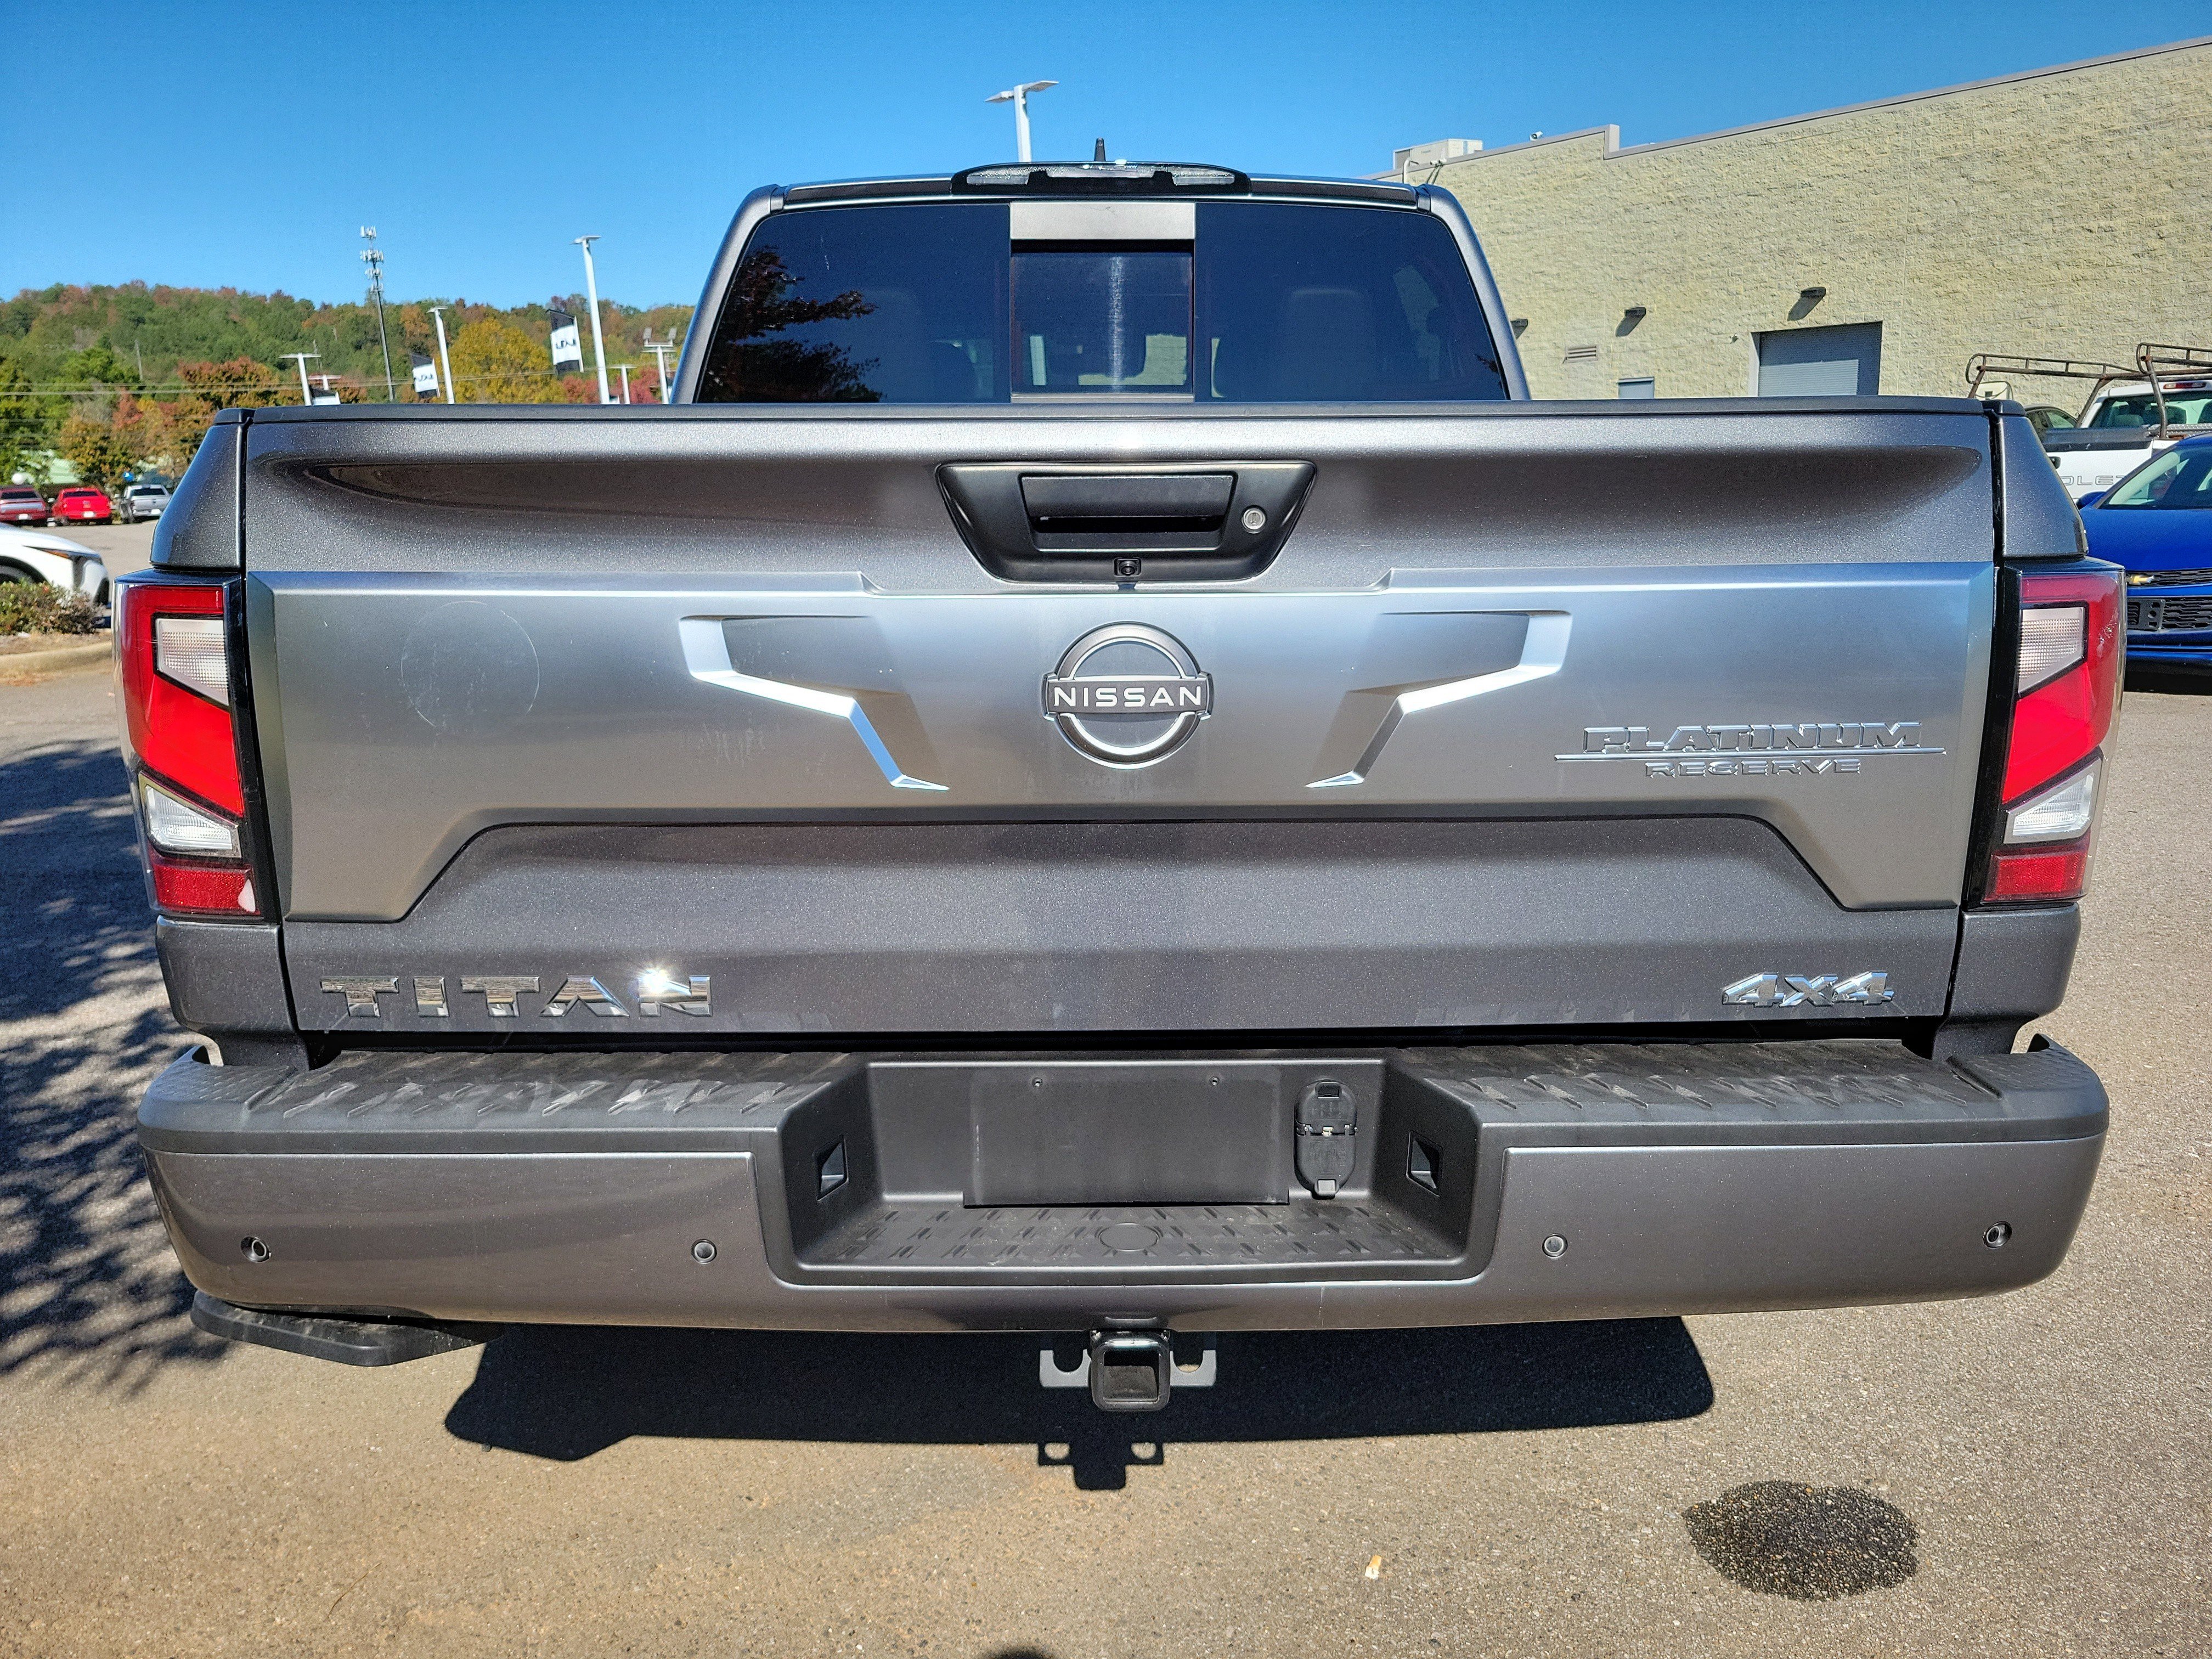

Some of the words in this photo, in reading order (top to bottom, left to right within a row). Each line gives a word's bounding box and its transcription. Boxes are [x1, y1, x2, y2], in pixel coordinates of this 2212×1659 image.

[2061, 475, 2126, 486] OLE
[1053, 686, 1201, 707] NISSAN
[1582, 721, 1922, 754] PLATINUM
[1645, 758, 1861, 778] RESERVE
[320, 975, 712, 1018] TITAN
